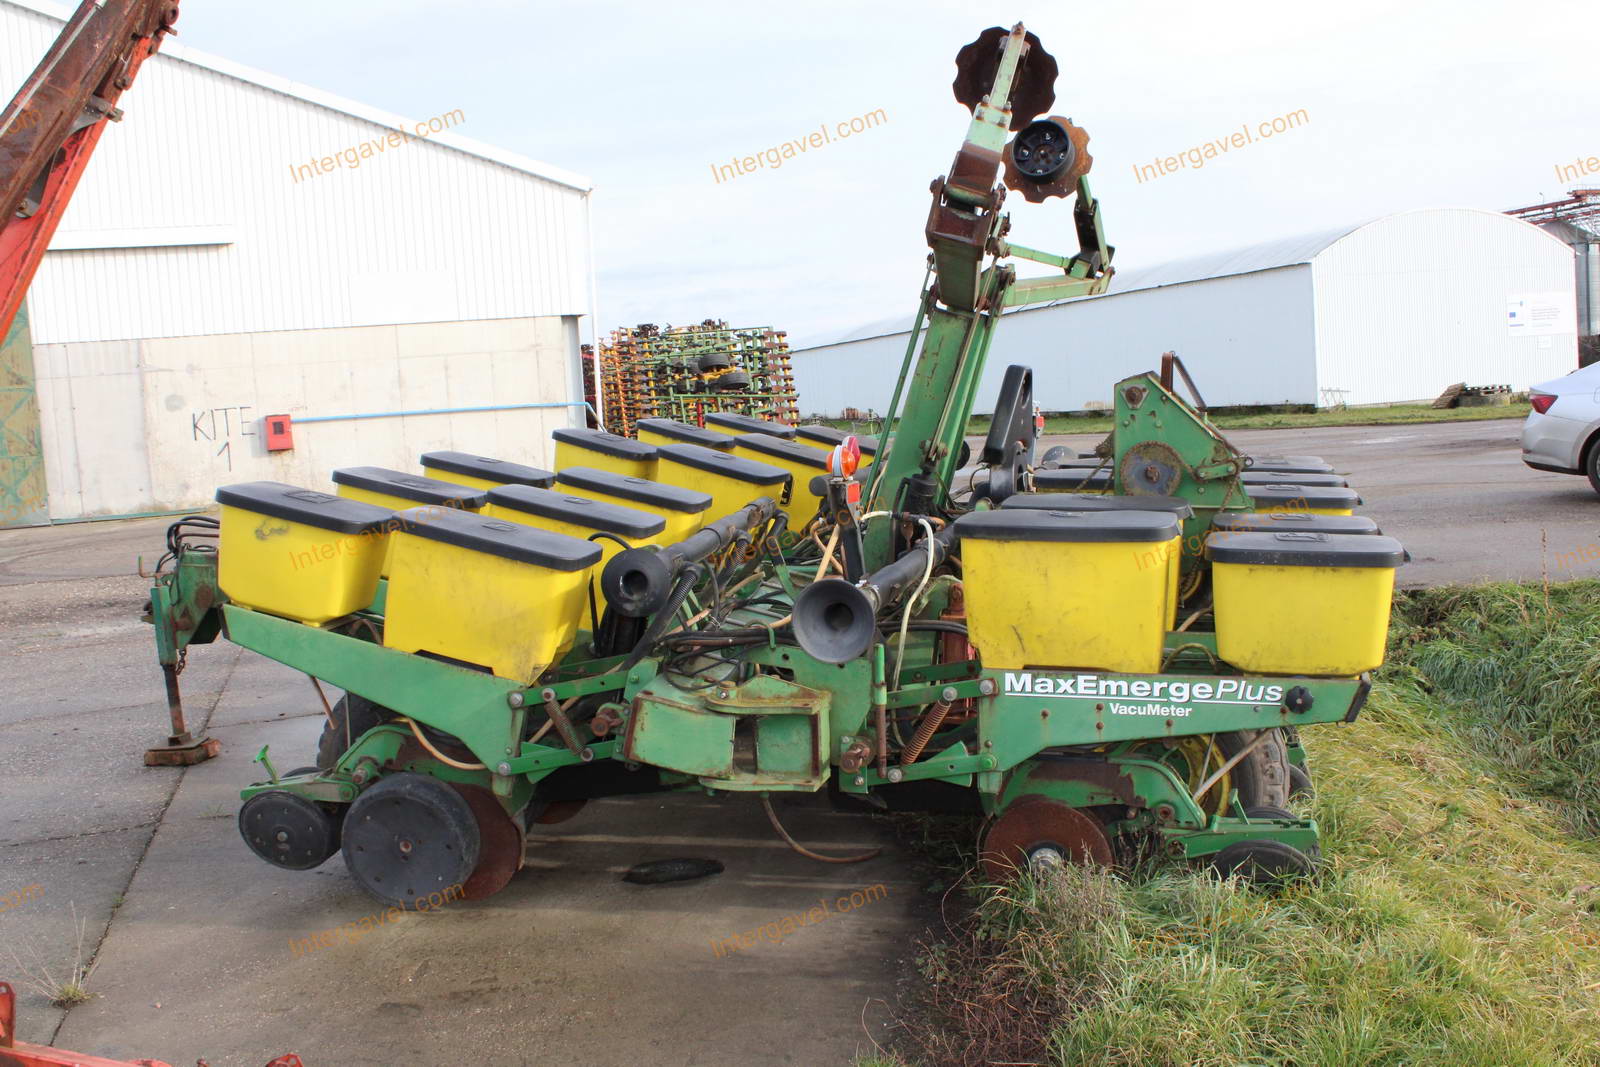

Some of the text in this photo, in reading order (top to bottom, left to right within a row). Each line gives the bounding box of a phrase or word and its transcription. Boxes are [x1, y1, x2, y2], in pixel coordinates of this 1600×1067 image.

[192, 406, 256, 441] KITE
[217, 441, 231, 472] 1
[1109, 702, 1192, 717] VacuMeter
